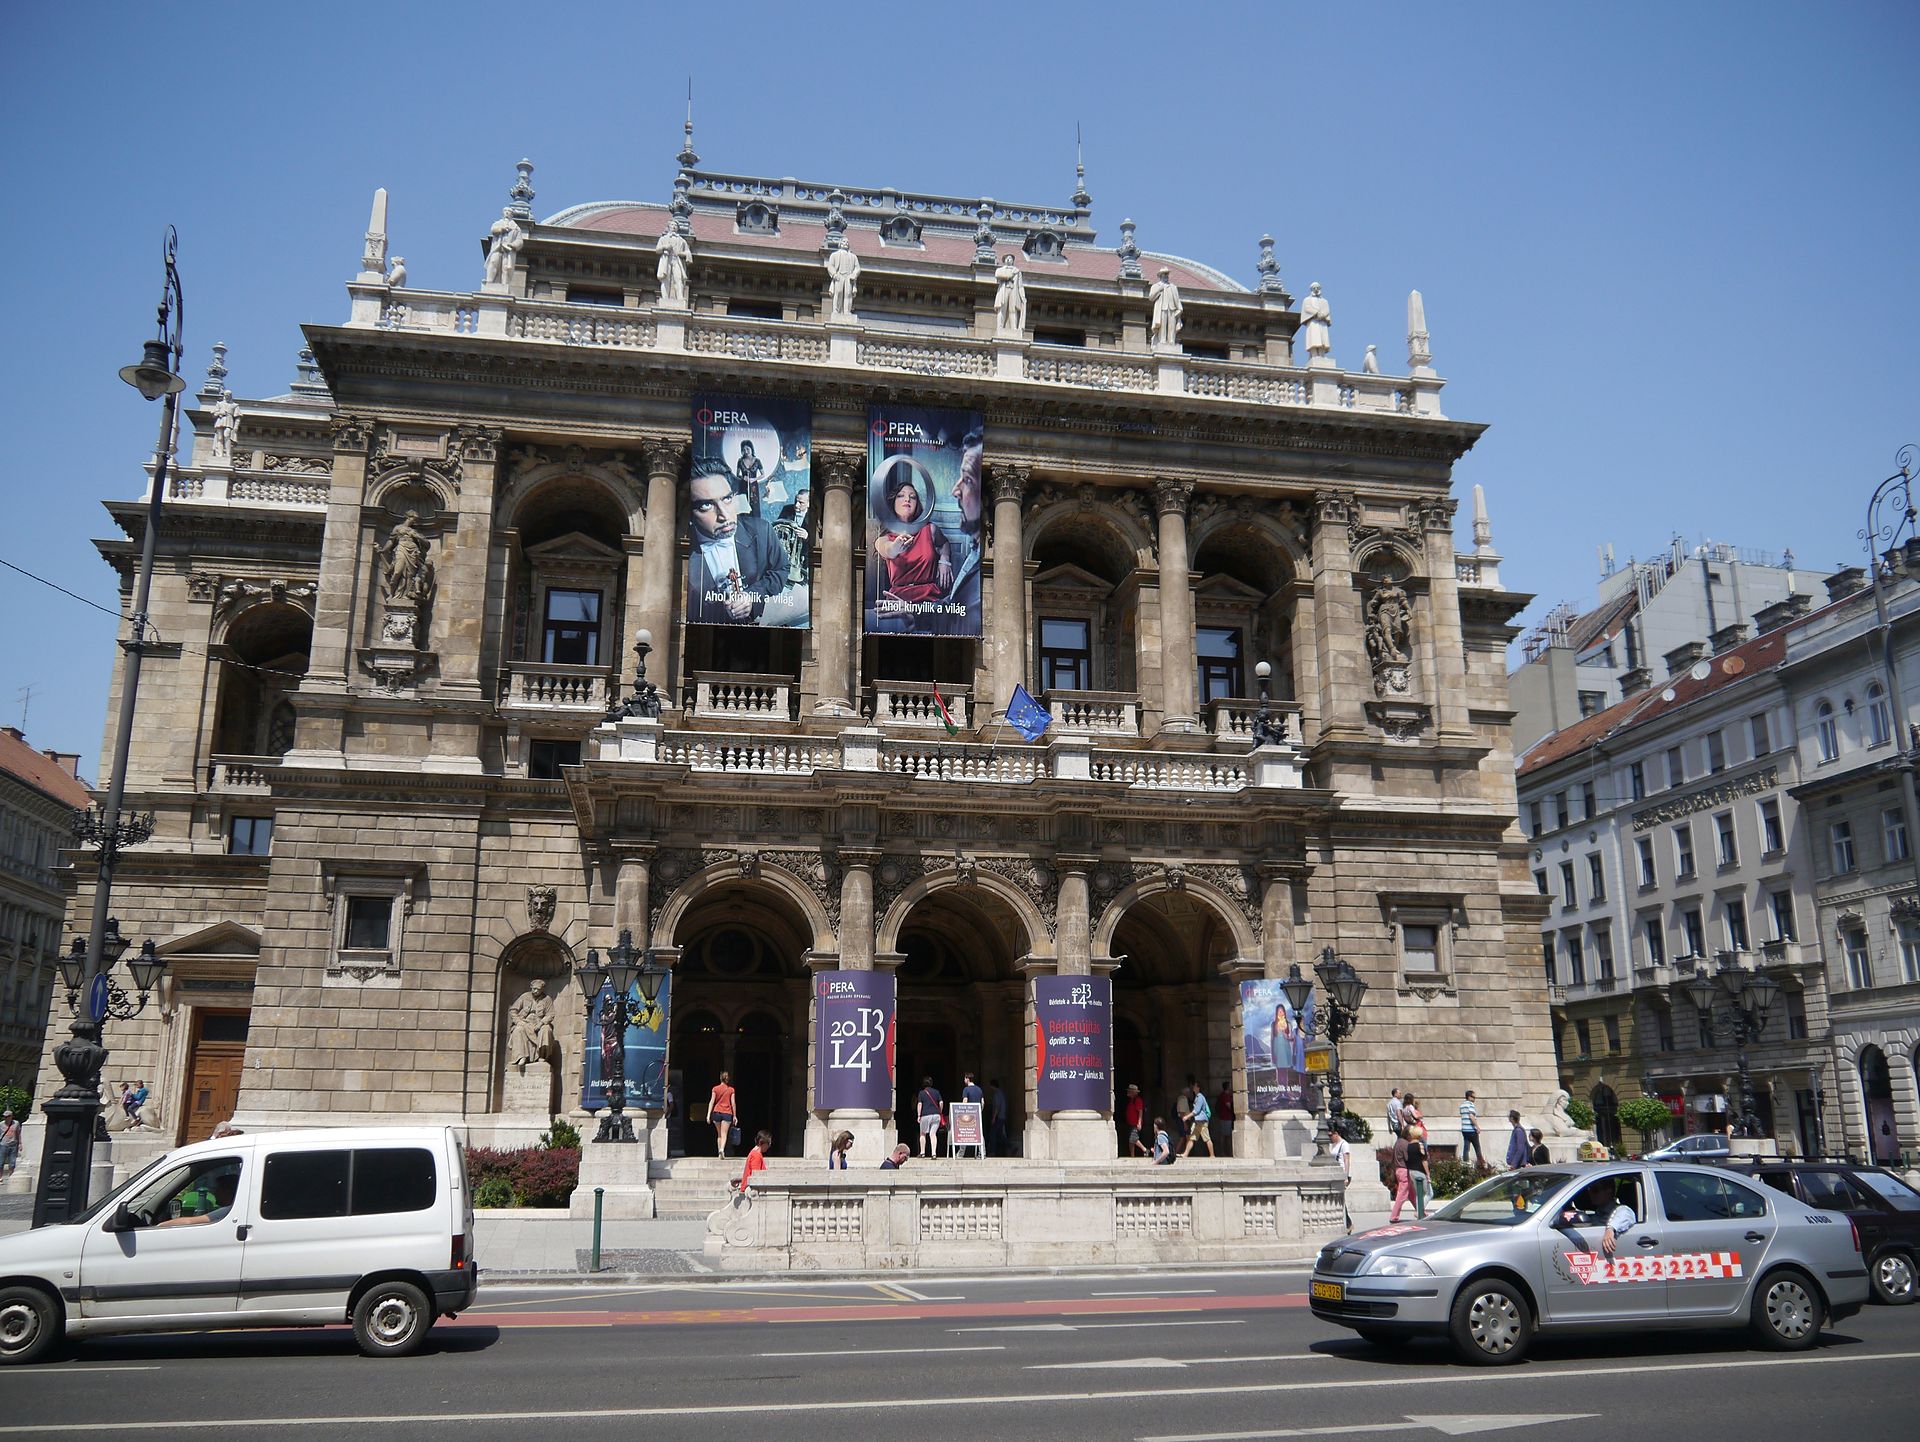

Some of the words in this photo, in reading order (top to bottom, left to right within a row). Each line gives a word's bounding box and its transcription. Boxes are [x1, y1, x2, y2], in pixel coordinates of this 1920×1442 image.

[697, 408, 749, 425] OPERA
[873, 420, 924, 436] OPERA
[705, 590, 726, 602] Ahol
[729, 590, 762, 605] kinyílik
[764, 594, 770, 603] a
[773, 592, 794, 606] világ
[881, 600, 901, 611] Ahol
[904, 601, 935, 615] kinyílik
[937, 604, 943, 613] a
[945, 602, 966, 616] világ
[818, 981, 855, 995] OPERA
[1071, 983, 1092, 999] 2013
[1245, 987, 1273, 998] OPERA
[830, 1007, 885, 1052] 2013
[1049, 1036, 1067, 1046] április
[1068, 1036, 1076, 1045] 15
[830, 1038, 872, 1083] 14
[1049, 1070, 1068, 1080] április
[1069, 1070, 1077, 1079] 22
[1083, 1070, 1098, 1080] június
[1257, 1085, 1267, 1093] Ahol
